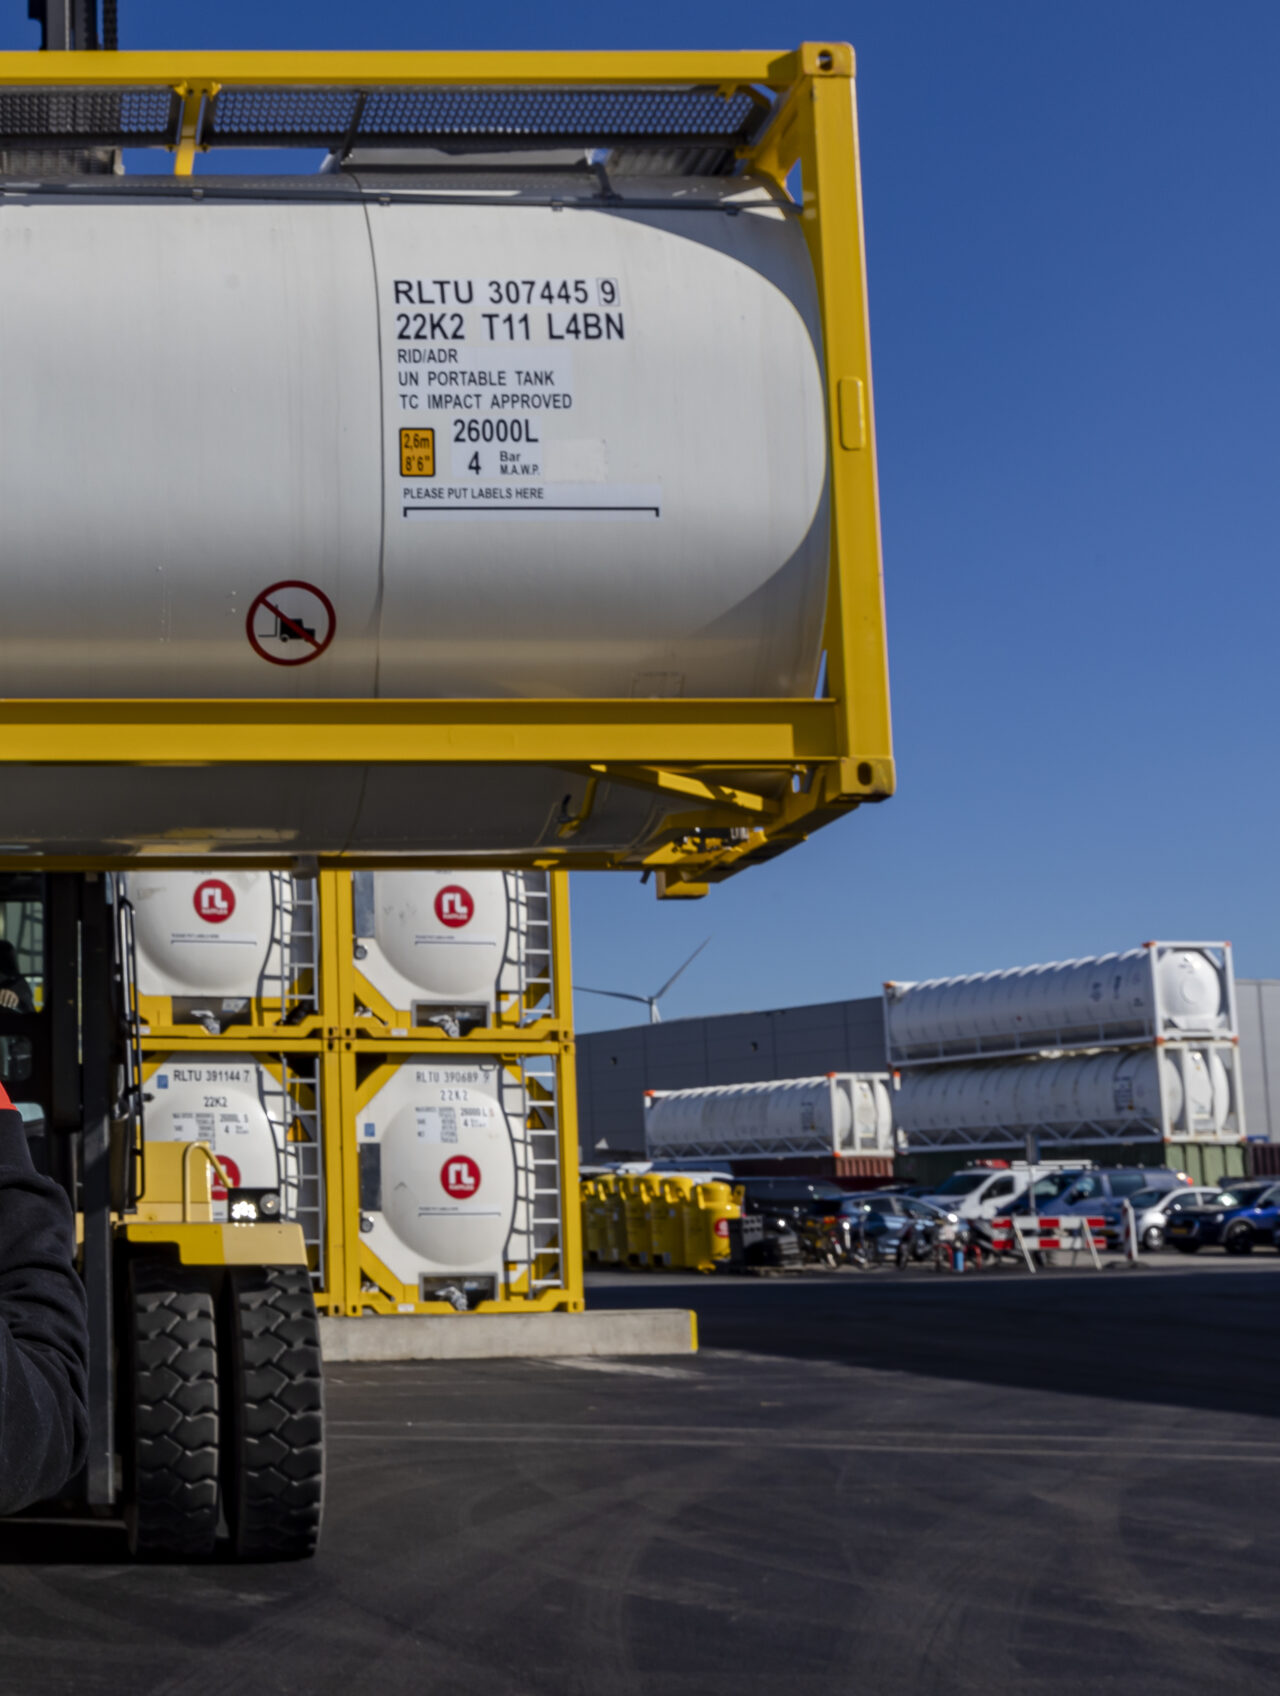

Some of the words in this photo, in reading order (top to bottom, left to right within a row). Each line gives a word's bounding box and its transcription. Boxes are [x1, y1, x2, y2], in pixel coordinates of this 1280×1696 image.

[394, 280, 474, 304] RLTU
[488, 281, 588, 304] 307445
[600, 280, 617, 304] 9
[396, 313, 465, 340] 22K2
[482, 314, 531, 340] T11
[547, 313, 625, 340] L4BN
[397, 349, 458, 364] RID/ADR
[398, 371, 419, 386] UN
[427, 371, 507, 386] PORTABLE
[515, 371, 555, 386] TANK
[399, 394, 419, 409] TC
[427, 394, 482, 409] IMPACT
[490, 394, 573, 409] APPROVED
[453, 419, 539, 442] 26000L
[468, 451, 482, 475] 4
[500, 451, 521, 462] Bar
[403, 488, 445, 500] PLEASE
[448, 488, 469, 499] PUT
[471, 488, 513, 500] LABELS
[515, 488, 545, 500] HERE
[173, 1070, 202, 1082] RLTU
[416, 1071, 440, 1083] RLTU
[203, 1096, 228, 1108] 22K2
